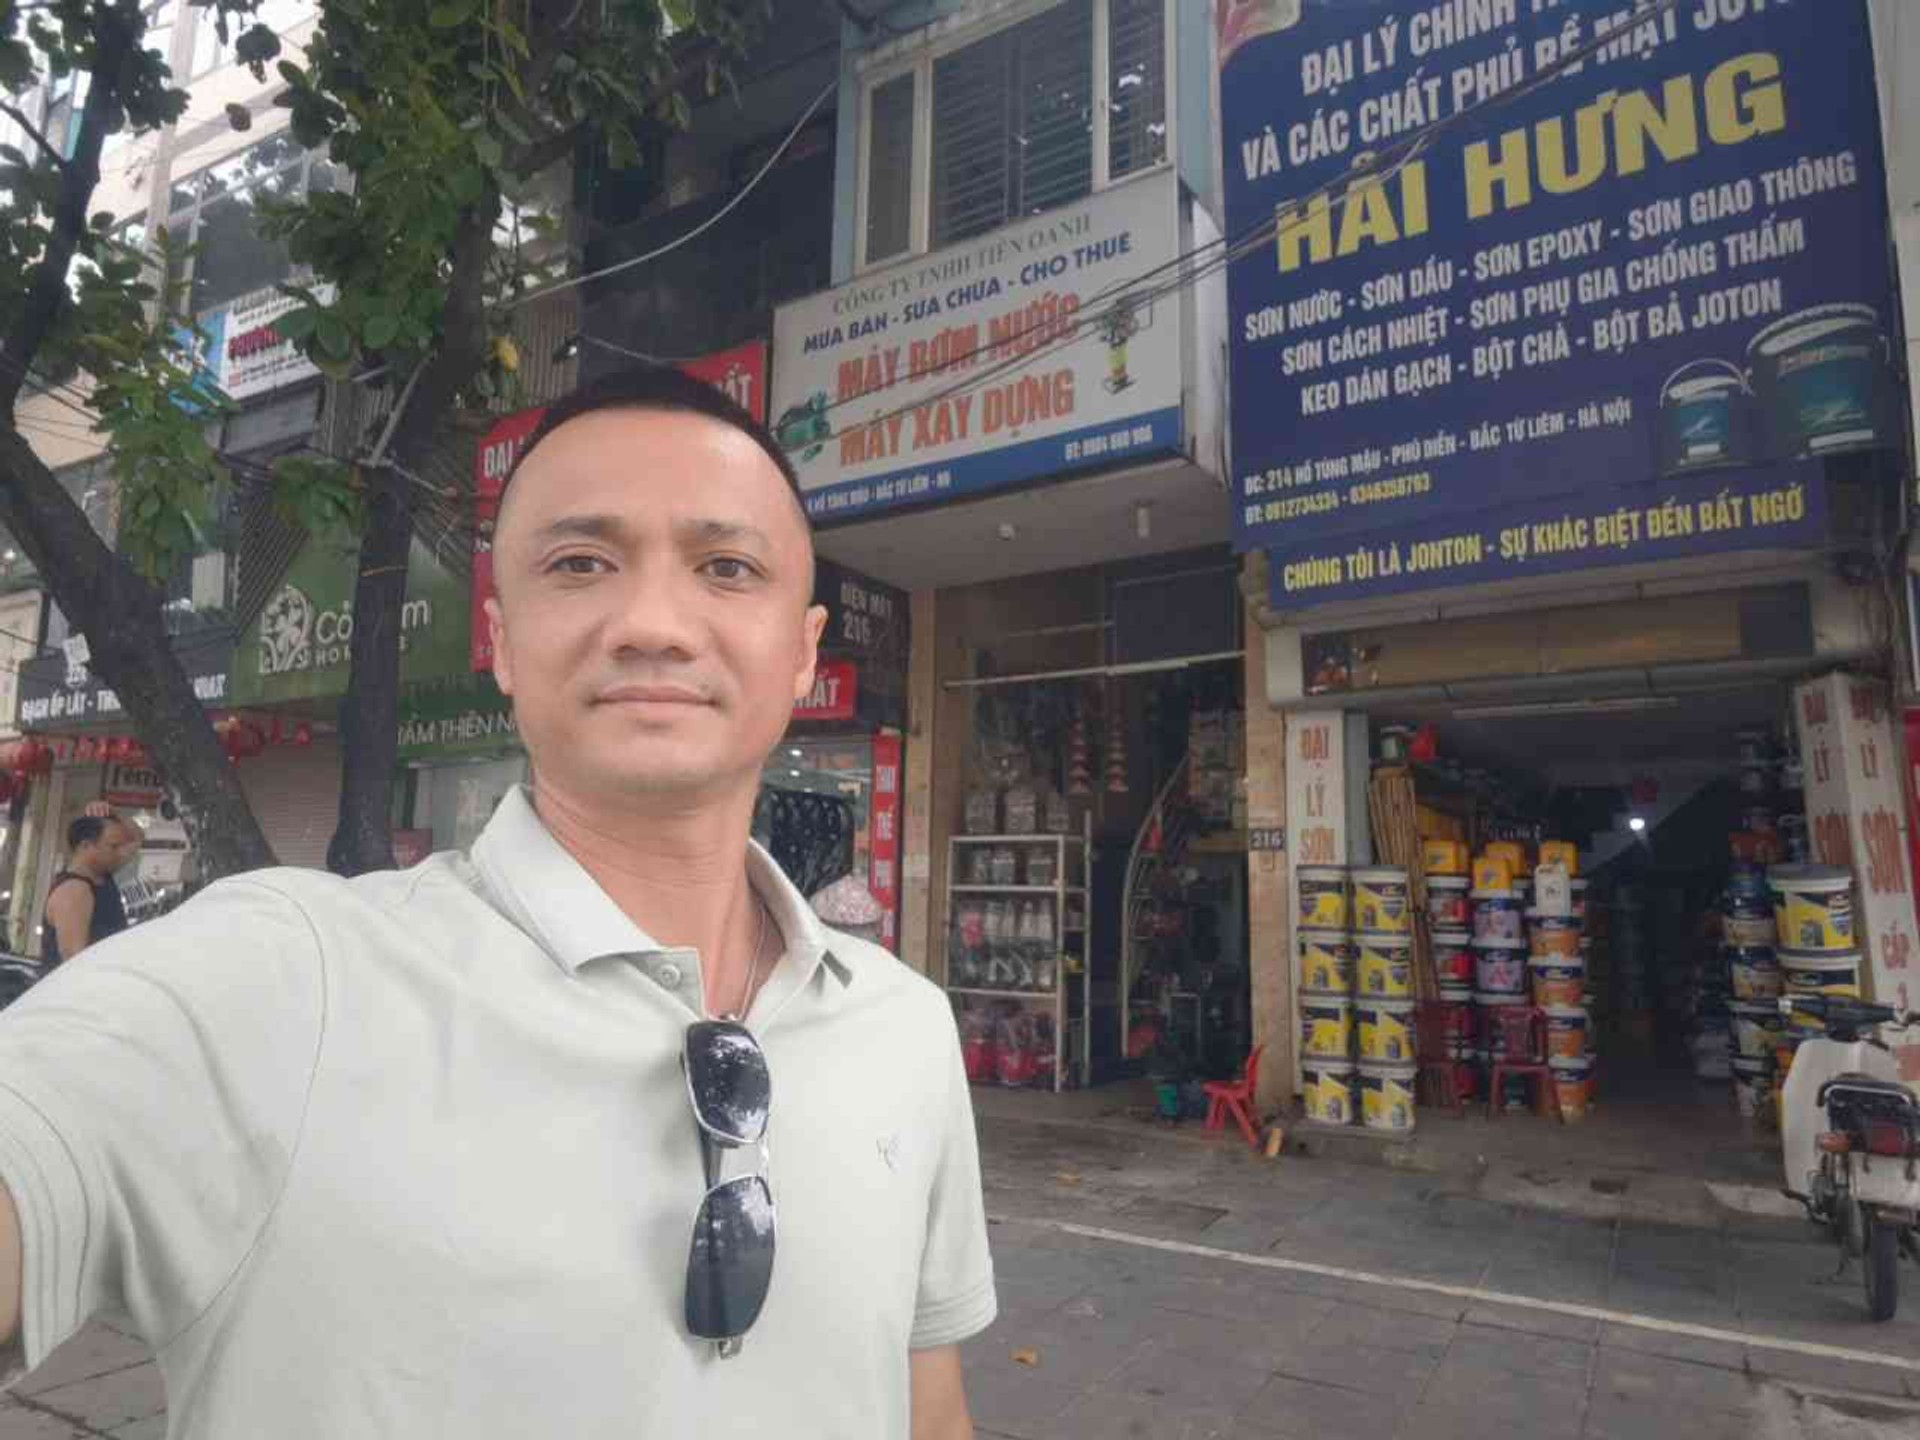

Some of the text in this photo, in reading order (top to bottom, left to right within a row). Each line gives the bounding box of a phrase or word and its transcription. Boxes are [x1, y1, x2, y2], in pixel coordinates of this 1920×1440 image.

[1242, 126, 1281, 181] VÀ
[1288, 107, 1350, 166] CÁC
[1359, 66, 1442, 143] CHẤT
[1452, 35, 1524, 114] PHỦ
[1301, 39, 1354, 96] ĐẠI
[1362, 14, 1399, 74] LÝ
[1275, 52, 1786, 272] HẢI HƯNG
[804, 326, 843, 354] MUA
[1021, 255, 1067, 286] CHO
[1245, 305, 1284, 341] SƠN
[1289, 288, 1342, 329] NƯỚC
[1361, 273, 1404, 311] SƠN
[1473, 242, 1522, 281] SƠN
[1527, 219, 1603, 270] EPOXY
[1628, 198, 1683, 242] SƠN
[1690, 178, 1754, 224] GIAO
[1761, 150, 1856, 204] THÔNG
[1282, 341, 1322, 376] SƠN
[1328, 323, 1382, 364] CÁCH
[1388, 305, 1449, 350] NHIỆT
[1470, 290, 1518, 330] SƠN
[1523, 276, 1571, 318] PHỤ
[1578, 266, 1619, 304] GIA
[1626, 238, 1718, 292] CHỐNG
[1724, 211, 1805, 269] THẤM
[838, 345, 899, 399] MÁY
[982, 368, 1074, 437] DỰNG
[1301, 380, 1340, 416] KEO
[1345, 365, 1388, 406] DÁN
[1393, 353, 1452, 397] GẠCH
[1473, 336, 1515, 380] BỘT
[1593, 307, 1641, 354] BỘT
[1647, 290, 1684, 339] BẢ
[1691, 276, 1782, 329] JOTON
[1283, 555, 1341, 591] CHÚNG
[1347, 546, 1373, 581] TÔI
[1379, 542, 1401, 577] LÀ
[1500, 523, 1528, 562] SỰ
[1534, 515, 1588, 553] KHÁC
[1594, 507, 1641, 548] BIỆT
[1647, 495, 1692, 539] ĐẾN
[1699, 487, 1743, 533] BẤT
